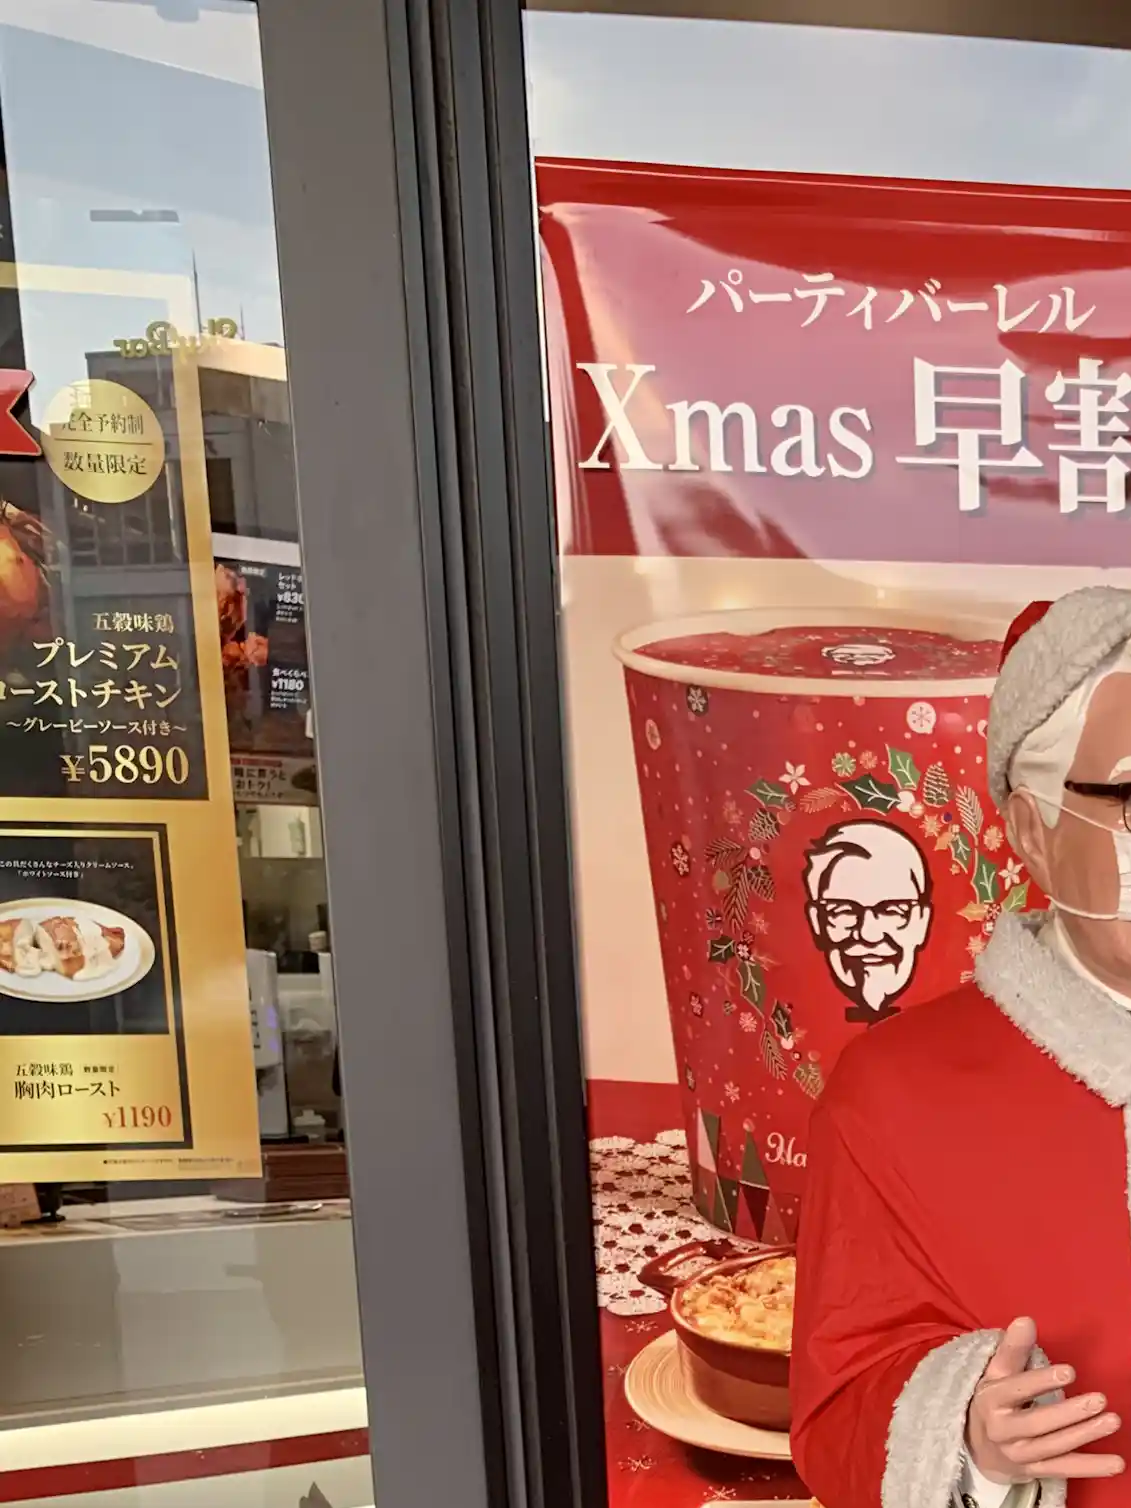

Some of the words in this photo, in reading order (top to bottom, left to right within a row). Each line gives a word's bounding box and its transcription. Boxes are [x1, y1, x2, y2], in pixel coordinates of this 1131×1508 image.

[686, 269, 1097, 334] パーティバーレル
[577, 361, 874, 479] Xmas
[64, 451, 147, 475] 数量限定
[32, 637, 179, 671] プレミアム
[0, 678, 182, 710] ーストチキン
[60, 745, 189, 785] ¥5890
[14, 1080, 121, 1099] 胸肉ロースト
